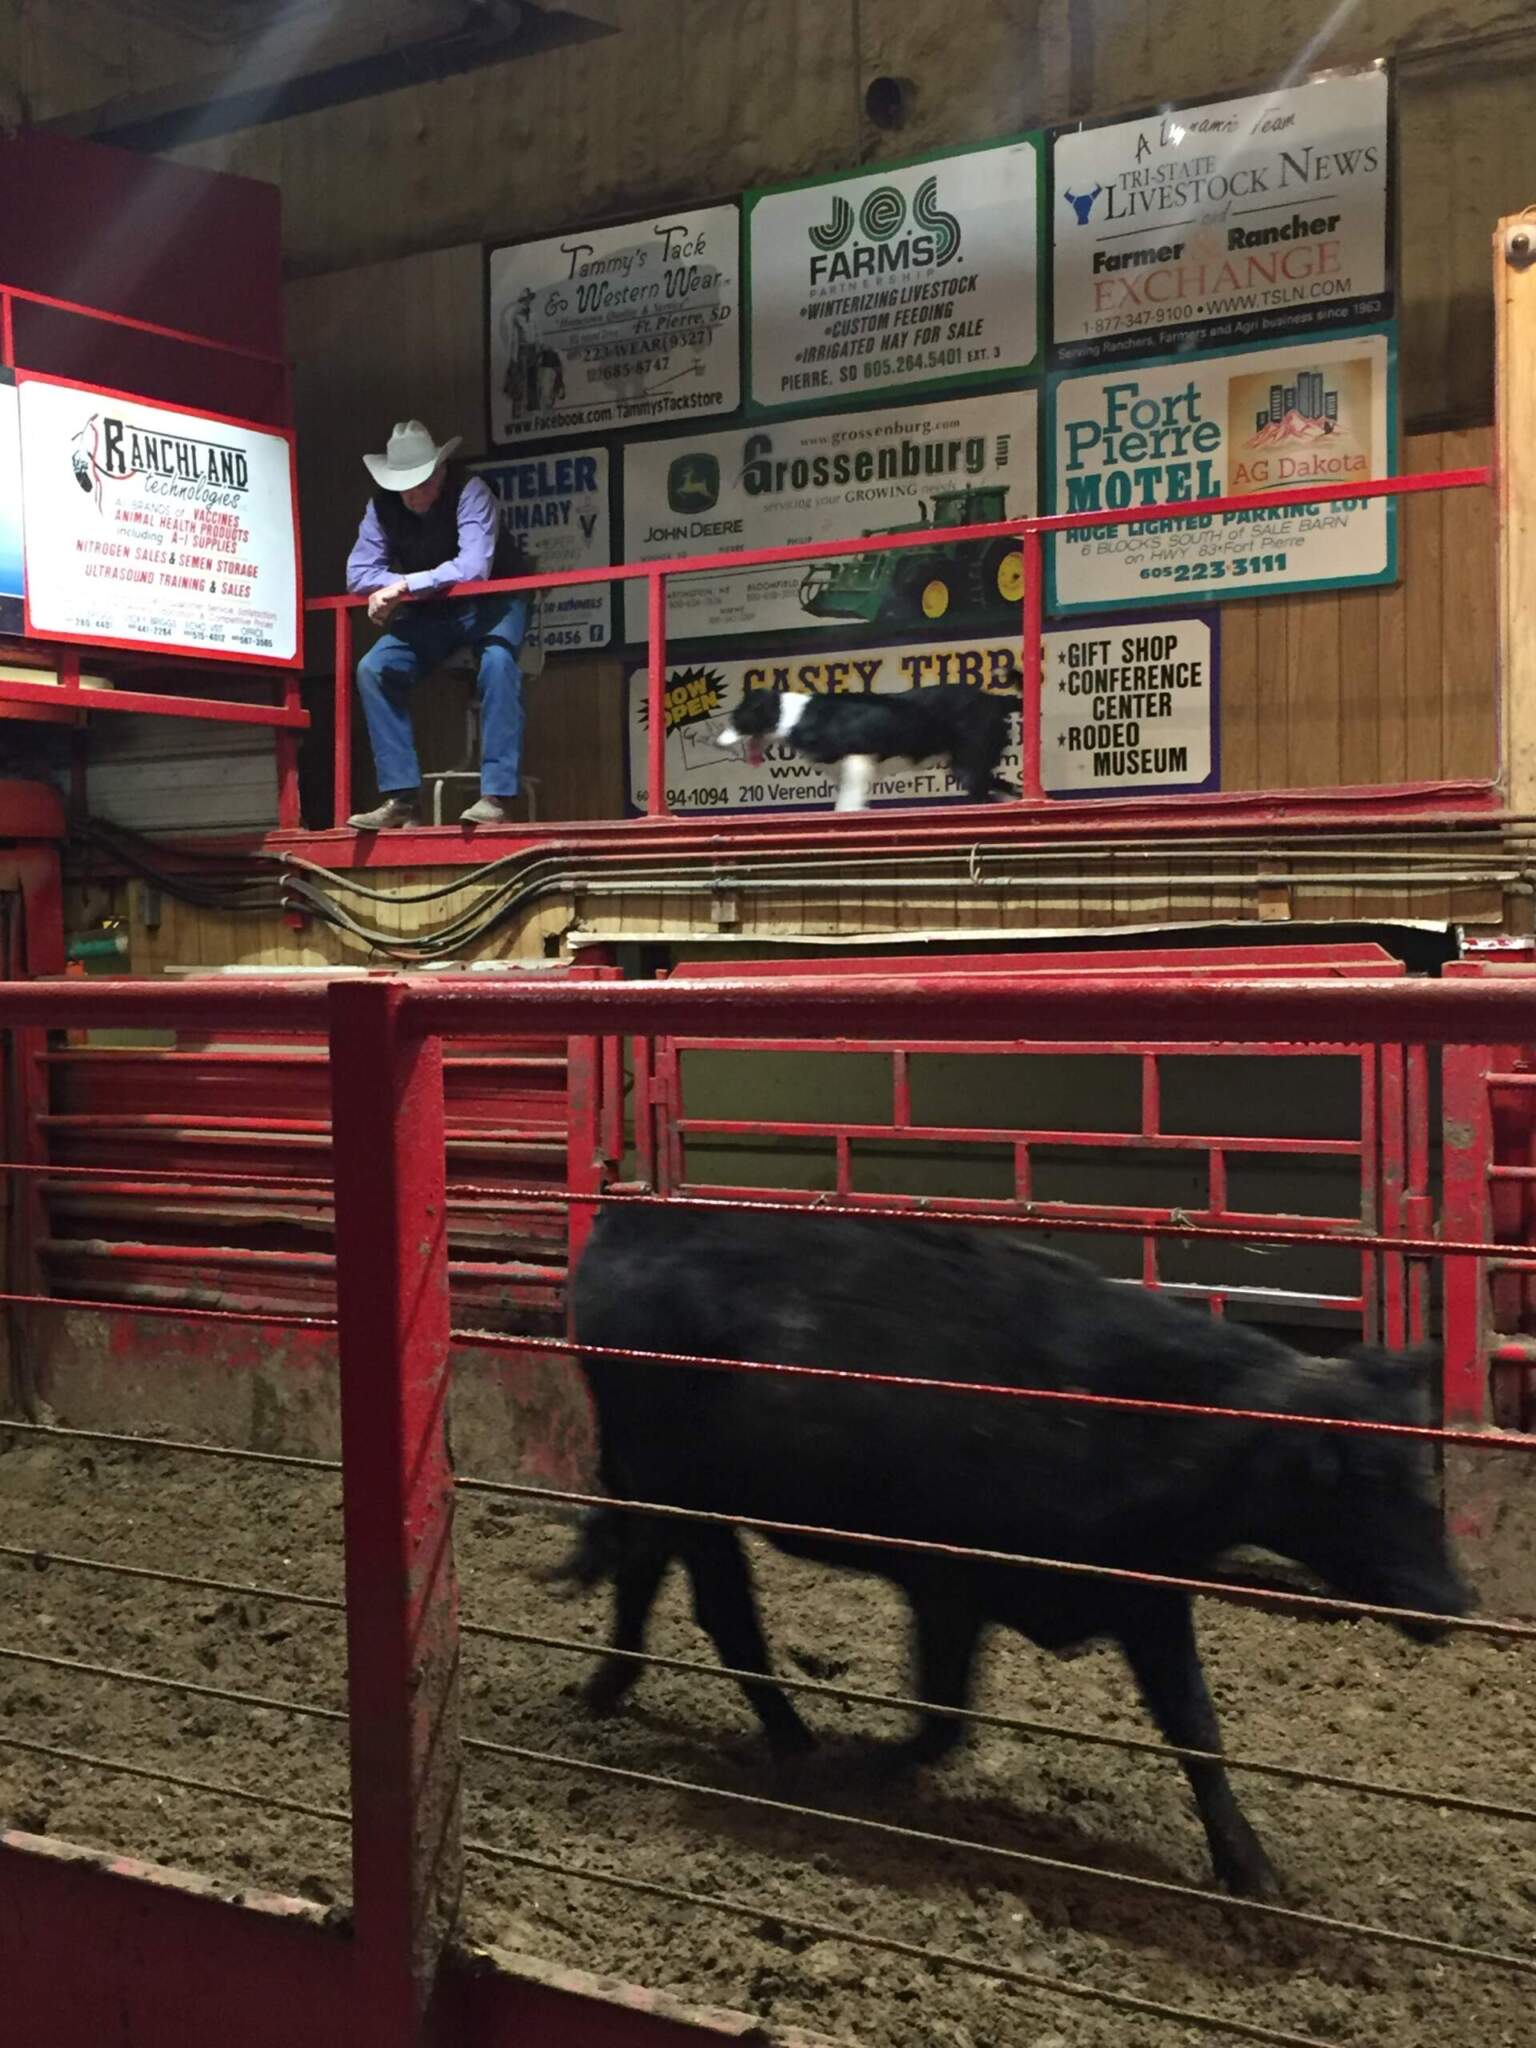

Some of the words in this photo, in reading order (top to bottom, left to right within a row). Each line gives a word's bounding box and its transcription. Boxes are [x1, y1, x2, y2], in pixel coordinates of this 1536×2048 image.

[1135, 132, 1152, 164] A
[1250, 107, 1296, 136] Team
[1103, 167, 1270, 222] LIVESTOCK
[1277, 146, 1379, 189] NEWS
[1119, 154, 1217, 192] TRI-STATE
[560, 242, 648, 280] Tammy's
[654, 224, 706, 262] Tack
[809, 233, 937, 286] FARMS
[1092, 242, 1187, 275] Farmer
[1227, 213, 1341, 252] Rancher
[808, 269, 935, 298] PARTNERSHIP
[1092, 240, 1343, 314] EXCHANGE
[575, 280, 660, 314] Western
[807, 288, 898, 321] WINTERIZING
[901, 273, 979, 305] LIVESTOCK
[831, 311, 889, 339] CUSTOM
[893, 301, 955, 327] FEEDING
[880, 332, 909, 354] HAY
[913, 325, 941, 347] FOR
[946, 318, 984, 341] SALE
[1159, 327, 1208, 345] Farmers
[1210, 324, 1232, 338] and
[1234, 319, 1259, 336] Agri
[1262, 312, 1314, 330] business
[1316, 307, 1348, 321] since
[839, 365, 858, 383] SD
[863, 347, 962, 378] 605.264.5401
[993, 345, 1001, 359] 3
[1102, 381, 1202, 435] Fort
[103, 416, 249, 488] RANCHLAND
[742, 433, 985, 496] Grossenburg
[1064, 420, 1221, 472] Pierre
[1065, 459, 1221, 516] MOTEL
[1233, 460, 1269, 486] AG
[1278, 453, 1368, 480] Dakota
[144, 472, 241, 513] technologies
[844, 484, 918, 504] GROWING
[115, 509, 154, 527] ANIMAL
[159, 516, 196, 533] HEALTH
[201, 523, 250, 543] PRODUCTS
[193, 508, 240, 528] VACCINES
[644, 523, 687, 543] JOHN
[690, 519, 743, 538] DEERE
[1065, 523, 1119, 544] HUGE
[1128, 513, 1212, 538] LIGHTED
[1222, 501, 1320, 527] PARKING
[1081, 543, 1091, 557] 6
[1096, 535, 1162, 556] BLOCKS
[1169, 530, 1223, 548] SOUTH
[1228, 528, 1246, 541] of
[1252, 520, 1291, 538] SALE
[1300, 515, 1351, 531] BARN
[76, 540, 130, 558] NITROGEN
[135, 547, 167, 564] SALES
[169, 552, 177, 565] &
[179, 554, 212, 571] SEMEN
[216, 560, 259, 578] STORAGE
[117, 527, 164, 546] including
[193, 535, 238, 554] SUPPLIES
[1124, 552, 1144, 566] on
[1150, 549, 1187, 561] HWY
[1260, 536, 1305, 549] Pierre
[85, 564, 154, 585] ULTRASOUND
[159, 573, 206, 592] TRAINING
[209, 580, 217, 593] &
[221, 583, 251, 598] SALES
[1068, 640, 1112, 668] GIFT
[1121, 635, 1178, 664] SHOP
[743, 658, 884, 695] CASEY
[1068, 662, 1203, 696] CONFERENCE
[1092, 693, 1172, 721] CENTER
[1068, 722, 1141, 751] RODEO
[1093, 747, 1188, 777] MUSEUM
[739, 785, 764, 802] 210
